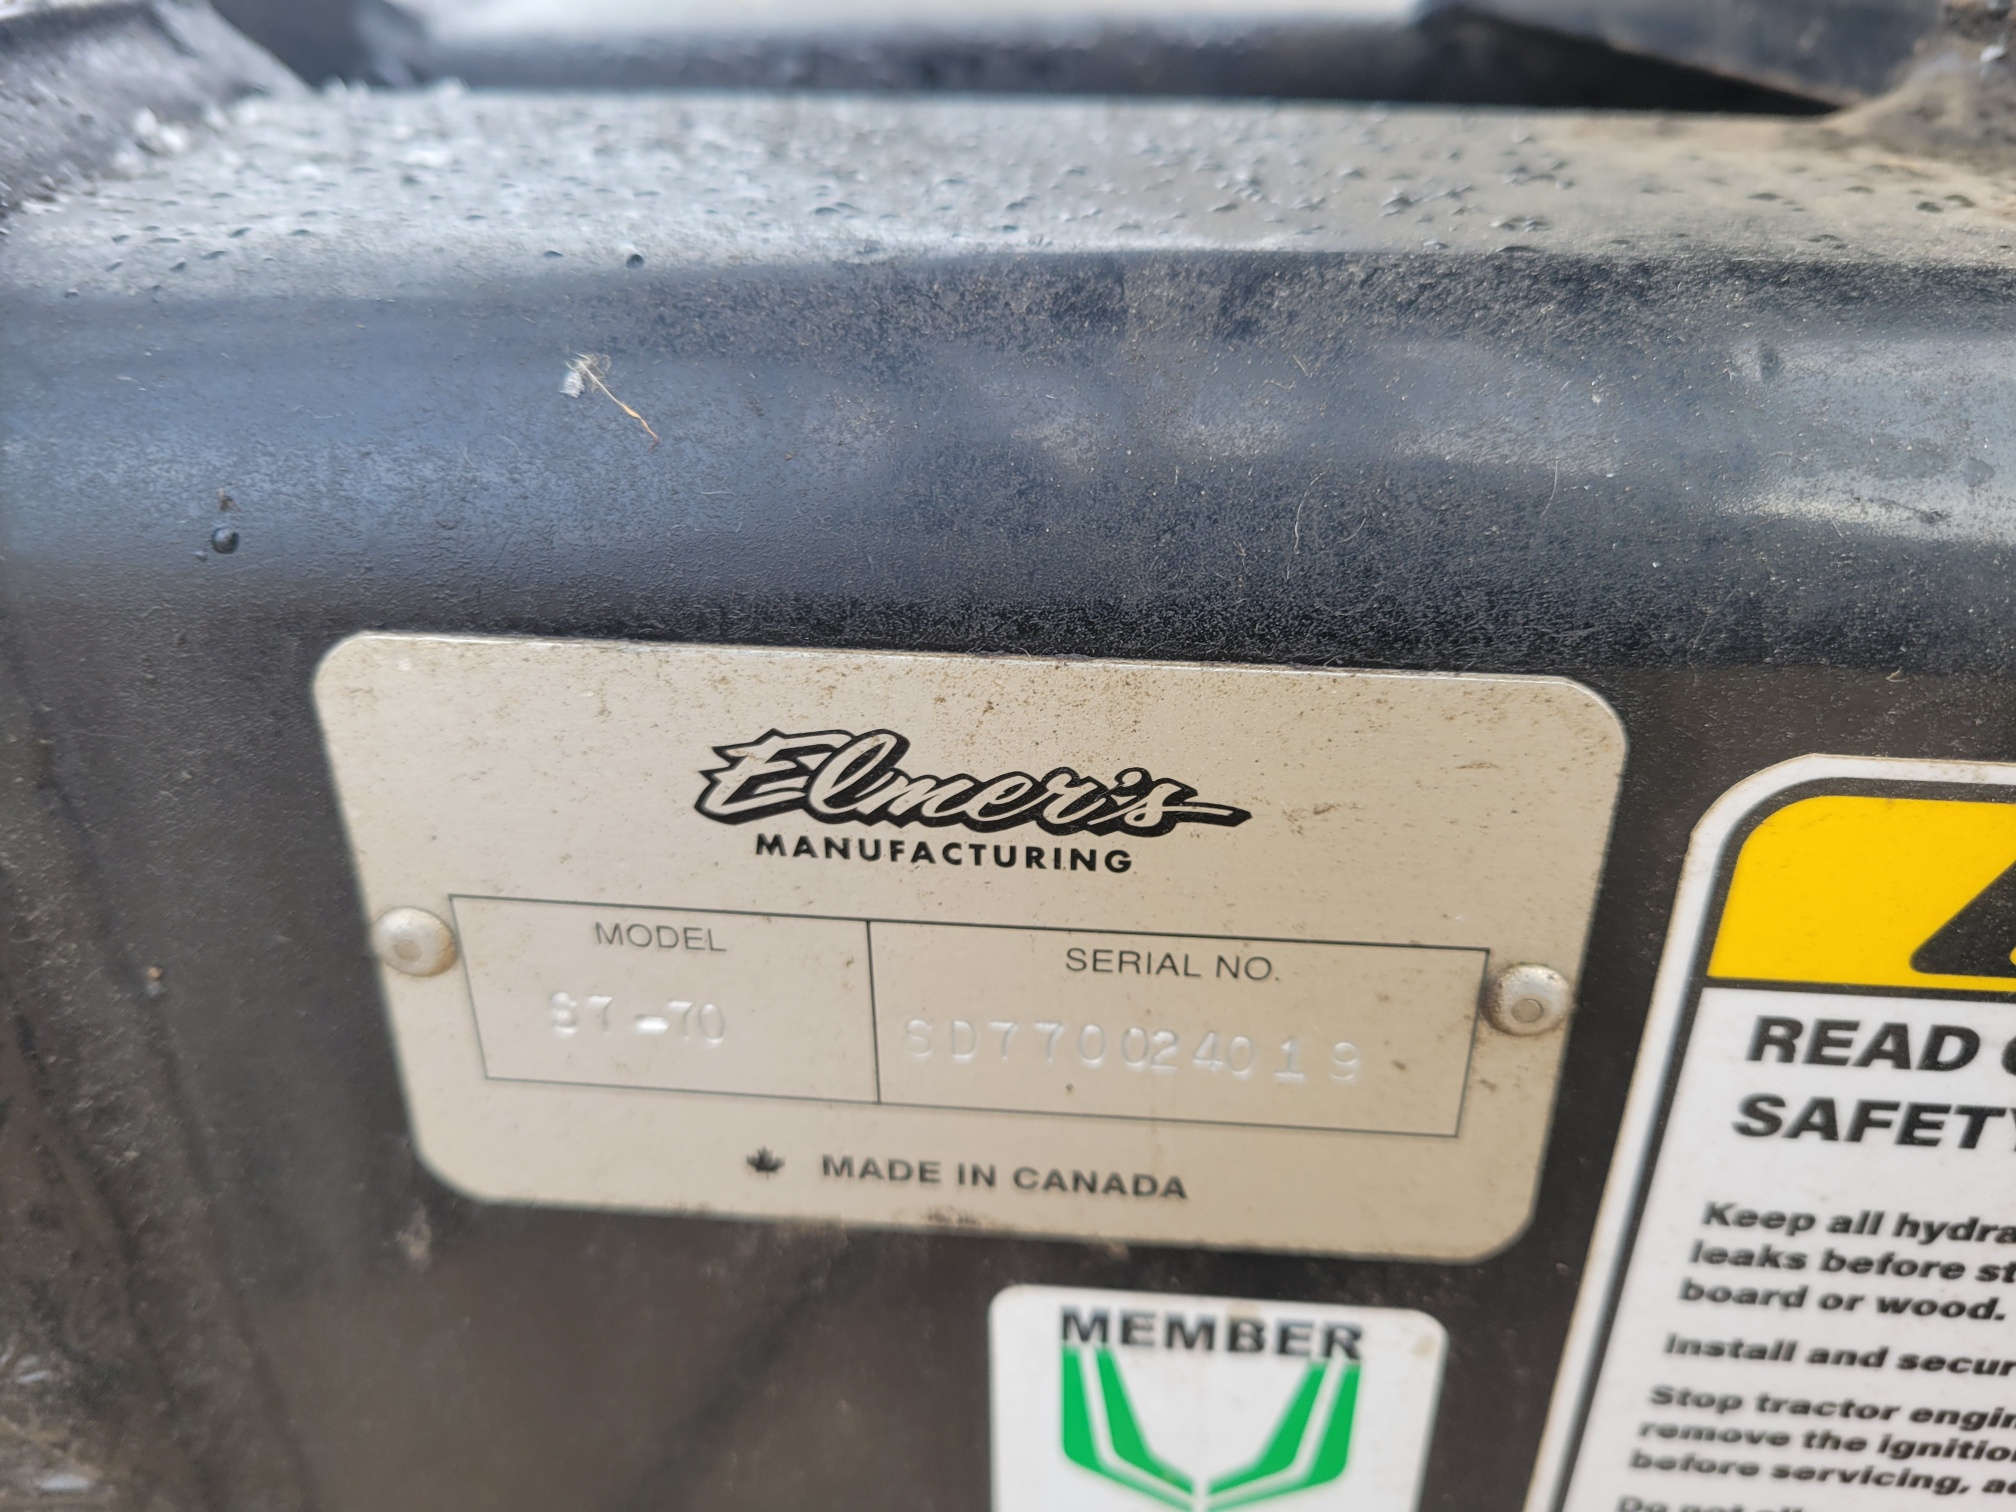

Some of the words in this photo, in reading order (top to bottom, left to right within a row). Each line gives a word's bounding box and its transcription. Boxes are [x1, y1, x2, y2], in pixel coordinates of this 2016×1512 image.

[694, 728, 1252, 837] Elmer's
[755, 833, 1132, 873] MANUFACTURING
[595, 921, 727, 952] MODEL
[1066, 948, 1201, 978] SERIAL
[1216, 956, 1280, 982] NO.
[1745, 1015, 1981, 1072] READ
[1731, 1093, 2016, 1152] SAFET
[822, 1154, 941, 1184] MADE
[957, 1162, 997, 1188] IN
[1012, 1166, 1190, 1200] CANADA
[1702, 1201, 1816, 1236] Keep
[1826, 1210, 1885, 1236] all
[1892, 1212, 2016, 1246] hydra
[1688, 1239, 1808, 1271] leaks
[1819, 1248, 1966, 1280] before
[1679, 1277, 1809, 1309] board
[1817, 1293, 1865, 1312] or
[1877, 1297, 2007, 1322] wood.
[1060, 1304, 1364, 1360] MEMBER
[1664, 1333, 1798, 1362] Install
[1805, 1346, 1890, 1368] and
[1649, 1385, 1743, 1415] Stop
[1755, 1392, 1901, 1422] tractor
[1639, 1421, 1791, 1447] remove
[1802, 1429, 1868, 1453] the
[1877, 1434, 2016, 1462] ignitio
[1629, 1449, 1760, 1477] before
[1770, 1464, 1972, 1496] servicing,
